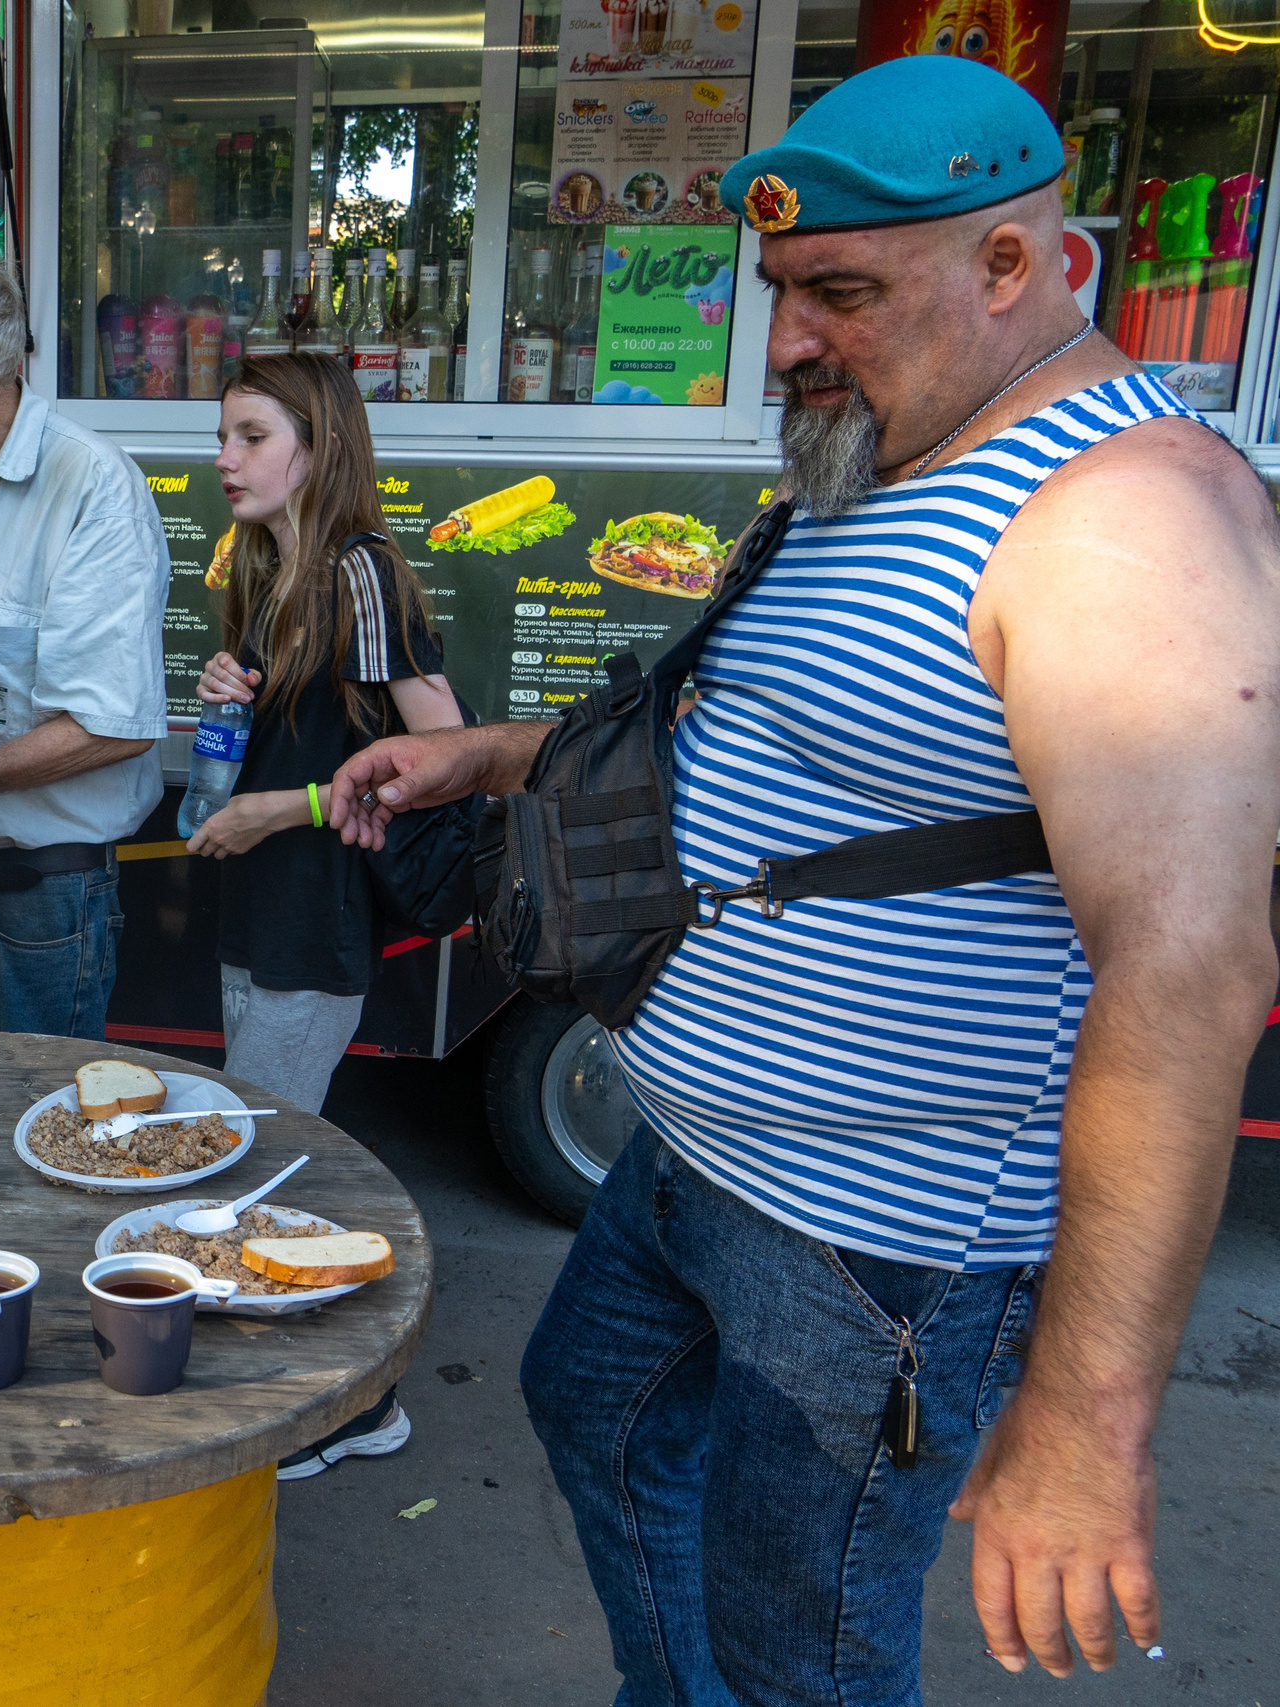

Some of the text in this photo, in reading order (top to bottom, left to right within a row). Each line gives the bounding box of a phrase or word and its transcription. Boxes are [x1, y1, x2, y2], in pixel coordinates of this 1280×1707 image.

[557, 112, 614, 125] Snickers
[631, 112, 668, 124] Oreo
[684, 109, 746, 123] Raffaelo
[606, 244, 732, 297] Лето
[612, 323, 682, 335] Ежедневно
[149, 332, 174, 343] Juice
[611, 339, 713, 352] с 10:00 до 22:00
[514, 351, 526, 365] RC
[529, 349, 549, 359] ROYAL
[357, 354, 395, 369] Barinoff
[400, 361, 420, 370] HEZA
[622, 362, 639, 370] (916)
[640, 362, 673, 370] 628-20-22
[376, 476, 410, 494] -дог
[381, 503, 424, 513] ссический
[181, 524, 204, 532] Hainz,
[404, 518, 431, 526] кетчуп
[392, 526, 424, 534] горчица
[516, 576, 602, 599] Пита-гриль
[520, 605, 606, 618] 350 Классическая
[514, 618, 672, 631] Куриное мясо гриль, салат, маринован-
[530, 628, 561, 637] огурцы,
[563, 629, 594, 637] томаты,
[595, 629, 643, 639] фирменный
[644, 632, 664, 640] соус
[513, 635, 629, 647] «Бургер», хрустящий лук фри
[517, 653, 538, 663] 350
[553, 654, 597, 665] халапеньо
[511, 666, 608, 677] Куриное мясо гриль, сал
[510, 675, 610, 685] томаты, фирменный соус
[542, 692, 576, 704] Сырная
[508, 705, 542, 714] Куриное
